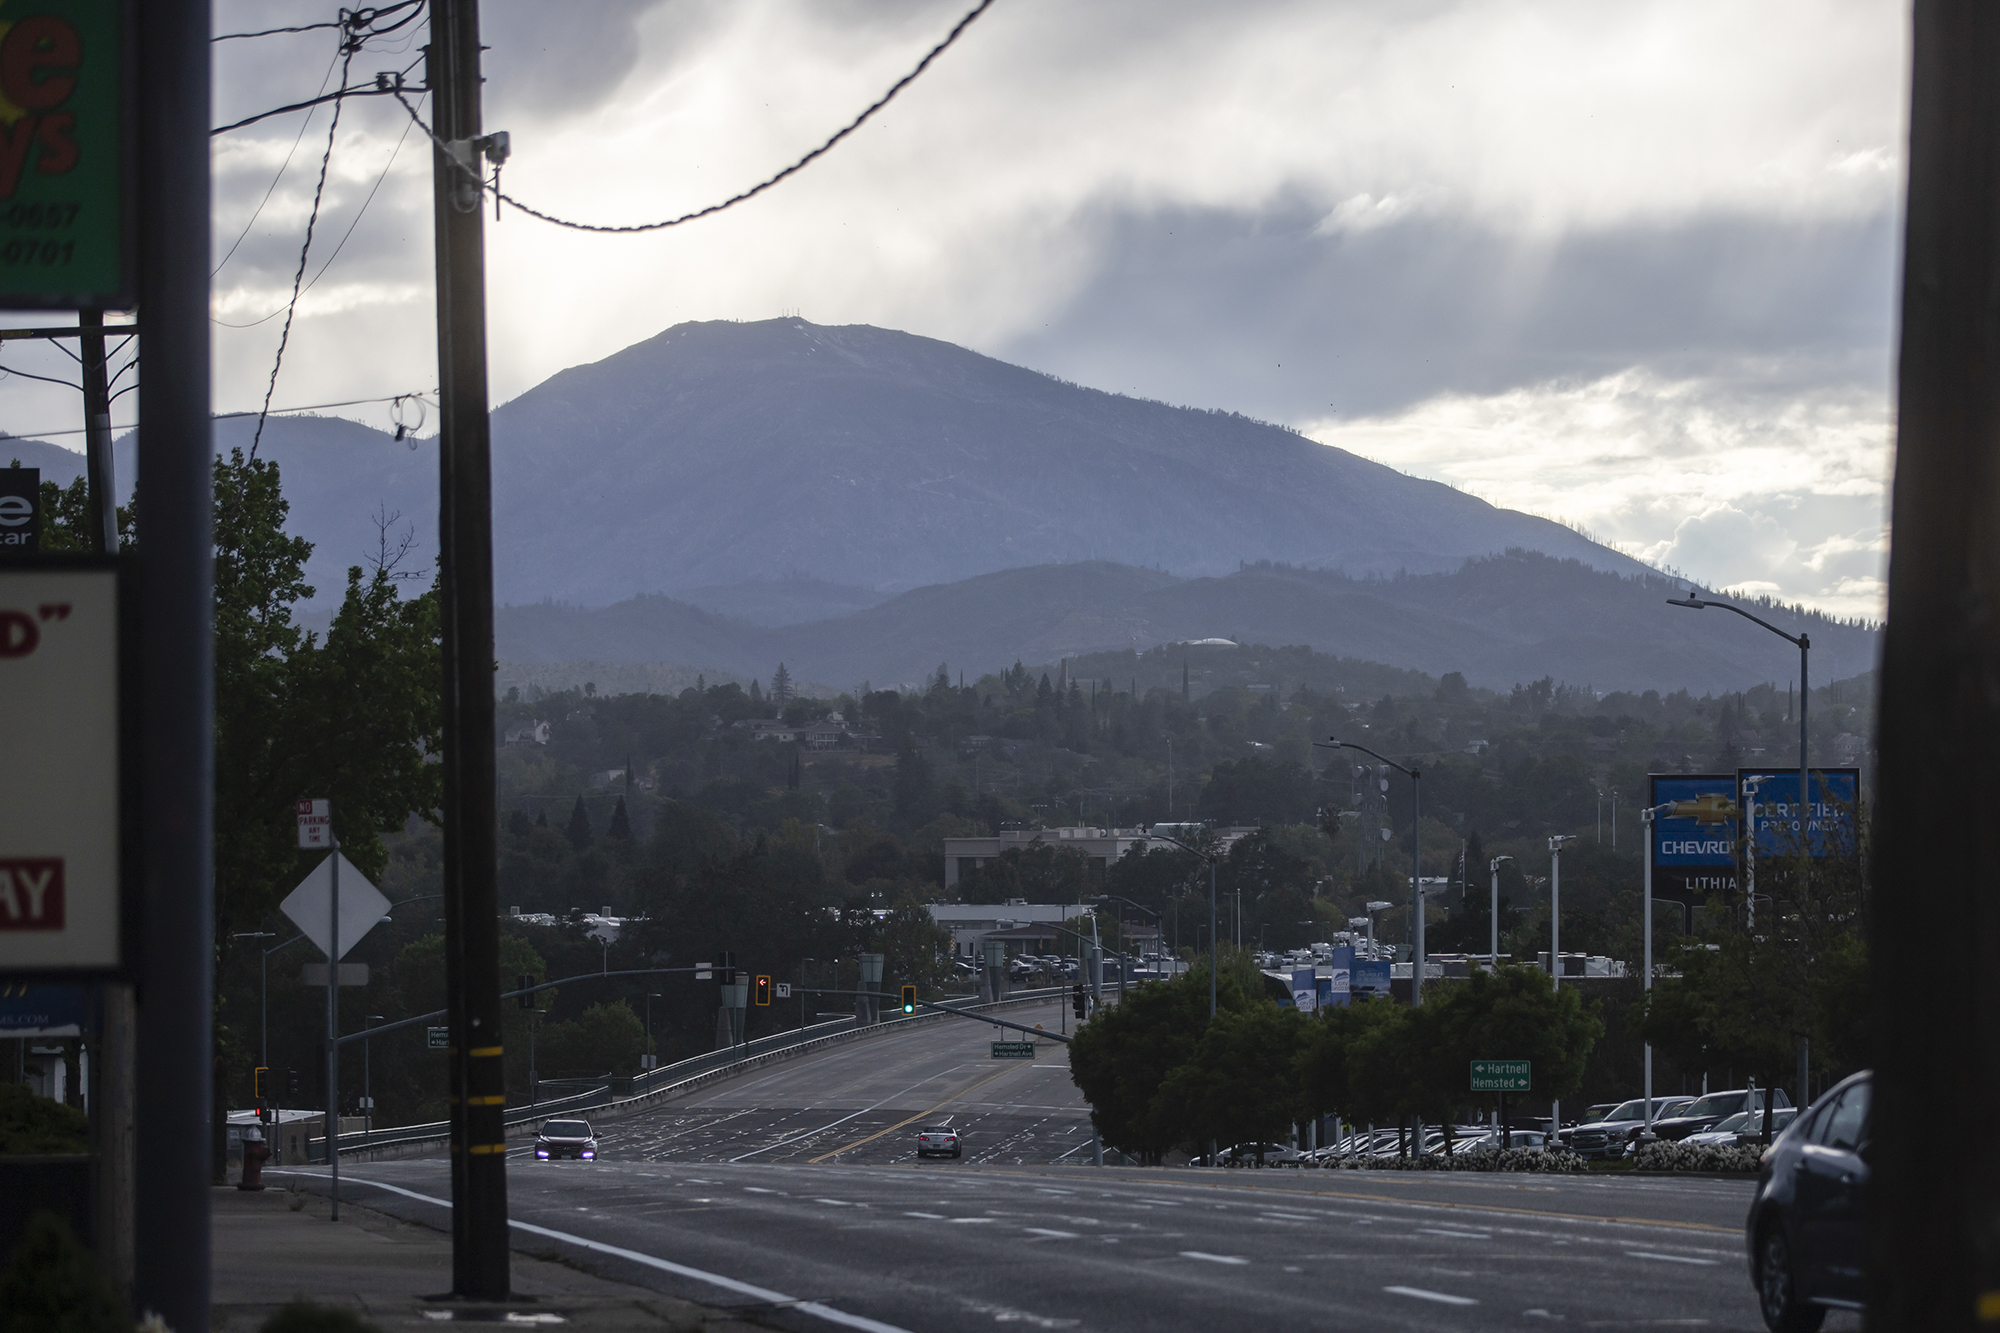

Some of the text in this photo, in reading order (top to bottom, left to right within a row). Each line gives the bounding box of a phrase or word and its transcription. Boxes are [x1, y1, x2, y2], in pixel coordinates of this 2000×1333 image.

[299, 802, 311, 813] NO
[299, 816, 330, 826] PARKING
[309, 835, 321, 843] TIME
[1686, 877, 1737, 889] LITHIA
[1487, 1063, 1528, 1074] Hartnell
[1472, 1077, 1515, 1088] Hemsted
